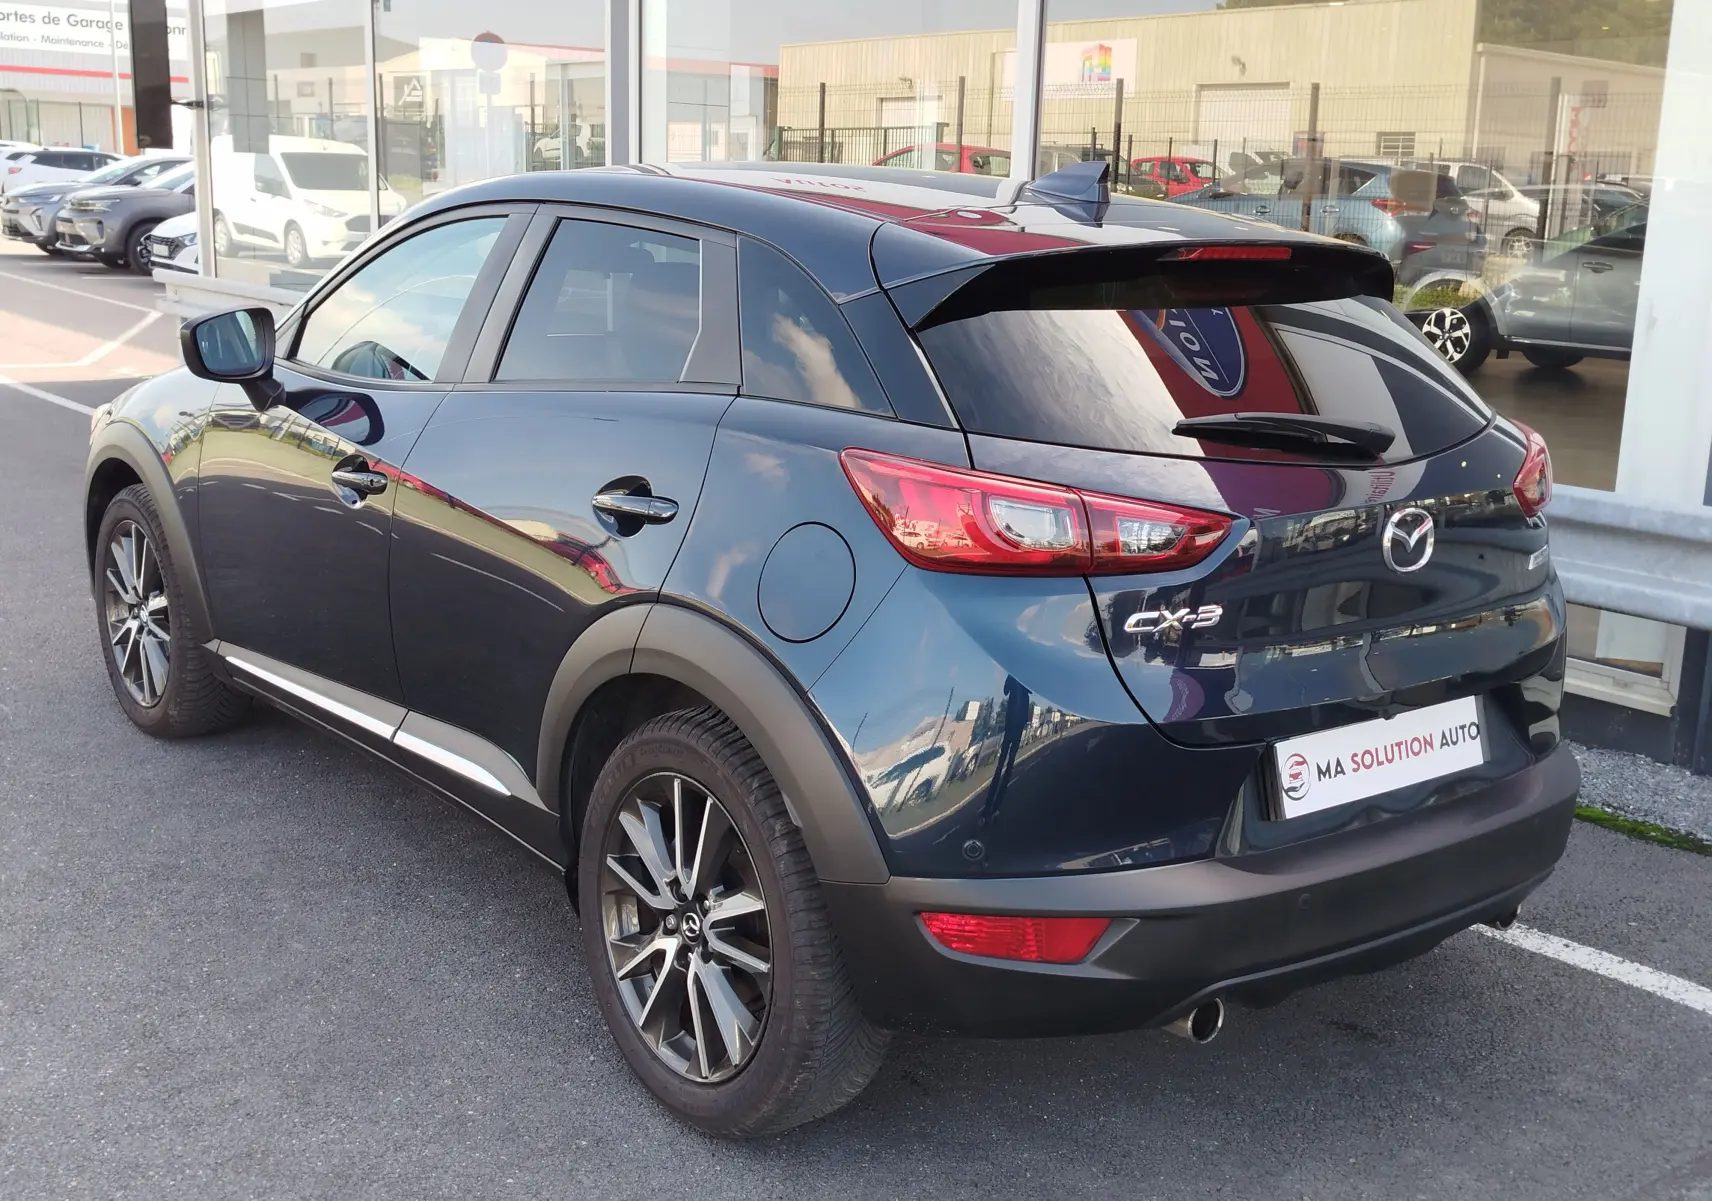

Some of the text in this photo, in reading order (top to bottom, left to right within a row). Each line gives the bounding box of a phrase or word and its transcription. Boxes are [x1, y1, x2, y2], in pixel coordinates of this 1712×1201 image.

[42, 11, 61, 26] de
[40, 34, 105, 49] Maintenance
[1124, 604, 1223, 633] CX-3
[1315, 721, 1481, 782] MA SOLUTION AUTO
